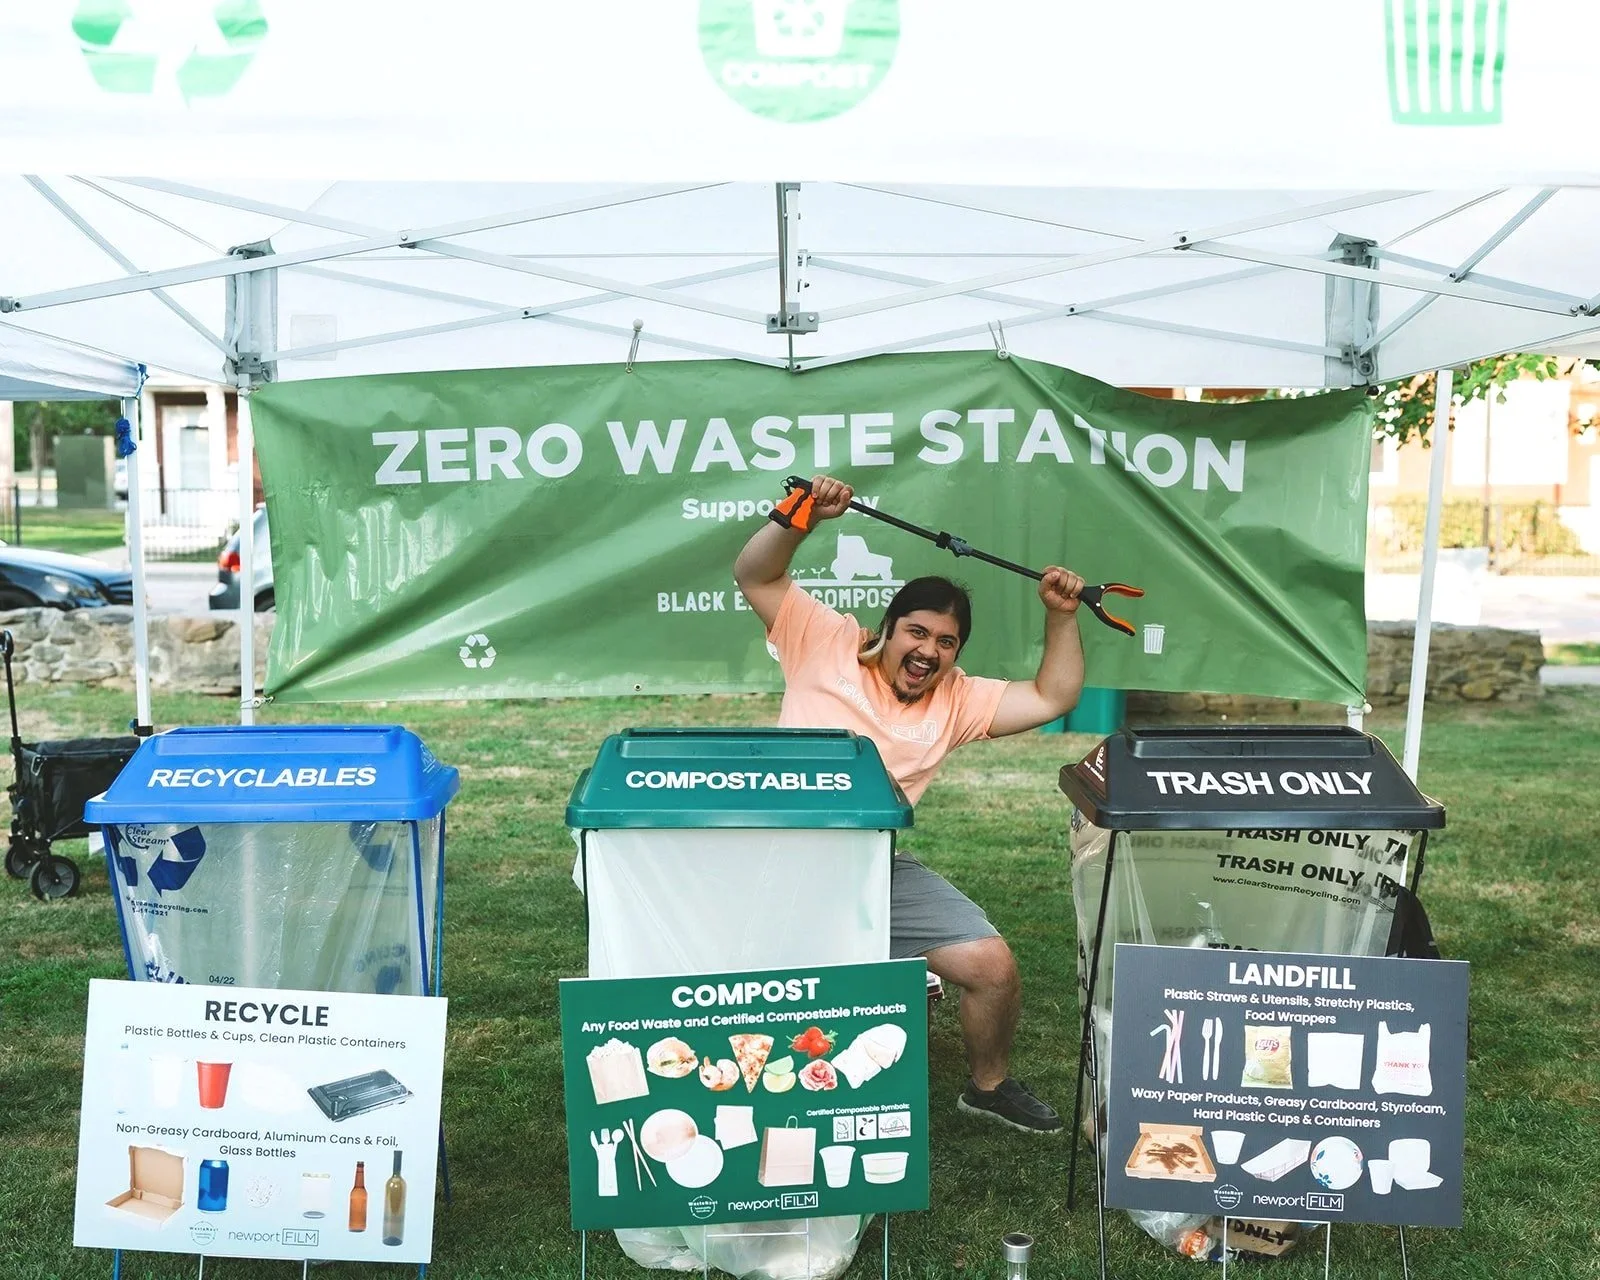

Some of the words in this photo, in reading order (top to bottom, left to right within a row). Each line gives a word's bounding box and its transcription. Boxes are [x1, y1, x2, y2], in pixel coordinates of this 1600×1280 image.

[722, 62, 873, 88] COMPOST
[371, 423, 583, 486] ZERO
[606, 412, 895, 475] WASTE
[917, 408, 1247, 493] STATION
[657, 591, 725, 612] BLACK
[810, 587, 898, 609] COMPOS
[147, 767, 377, 788] RECYCLABLES
[626, 771, 852, 791] COMPOSTABLES
[1147, 771, 1274, 795] TRASH
[1279, 771, 1373, 795] ONLY
[127, 825, 152, 836] Clear
[1308, 829, 1371, 850] ONLY
[1217, 854, 1294, 876] TRASH
[1301, 864, 1364, 887] ONLY
[1213, 875, 1361, 905] www.ClearStreamRecycling.com
[209, 975, 235, 985] 04/22
[1229, 962, 1356, 990] LANDFILL
[671, 977, 820, 1008] COMPOST
[1164, 988, 1204, 1001] Plastic
[1206, 990, 1247, 1003] Straws
[1250, 993, 1259, 1003] &
[1262, 993, 1312, 1007] Utensils,
[1314, 996, 1364, 1011] Stretchy
[1366, 998, 1415, 1012] Plastics,
[205, 1000, 329, 1027] RECYCLE
[582, 1021, 605, 1034] Any
[608, 1019, 639, 1031] Food
[641, 1018, 681, 1030] Waste
[684, 1016, 708, 1027] and
[711, 1013, 764, 1026] Certified
[766, 1007, 850, 1024] Compostable
[853, 1003, 907, 1016] Products
[1245, 1009, 1275, 1021] Food
[1278, 1011, 1336, 1026] Wrappers
[125, 1025, 163, 1038] Plastic
[167, 1027, 207, 1039] Bottles
[210, 1030, 220, 1040] &
[222, 1030, 256, 1044] Cups,
[259, 1032, 294, 1044] Clean
[298, 1034, 337, 1046] Plastic
[340, 1036, 406, 1049] Containers
[806, 1108, 834, 1116] Certified
[835, 1104, 880, 1115] Compostable
[1131, 1087, 1164, 1102] Waxy
[1167, 1089, 1203, 1104] Paper
[1205, 1092, 1261, 1107] Products,
[1264, 1095, 1307, 1111] Greasy
[1310, 1098, 1379, 1113] Cardboard,
[1381, 1101, 1446, 1116] Styrofoam,
[1193, 1108, 1223, 1120] Hard
[1225, 1109, 1266, 1122] Plastic
[1268, 1112, 1300, 1126] Cups
[1302, 1114, 1312, 1125] &
[1314, 1114, 1380, 1128] Containers
[116, 1122, 189, 1140] Non-Greasy
[192, 1126, 261, 1141] Cardboard,
[264, 1130, 326, 1144] Aluminum
[329, 1133, 361, 1145] Cans
[364, 1135, 373, 1145] &
[376, 1134, 399, 1148] Foil,
[219, 1145, 252, 1156] Glass
[255, 1146, 296, 1159] Bottles
[728, 1197, 780, 1211] newport
[784, 1194, 816, 1207] FILM
[1253, 1194, 1305, 1208] newport
[1309, 1195, 1342, 1209] FILM
[228, 1230, 280, 1243] newport
[285, 1231, 316, 1244] FILM
